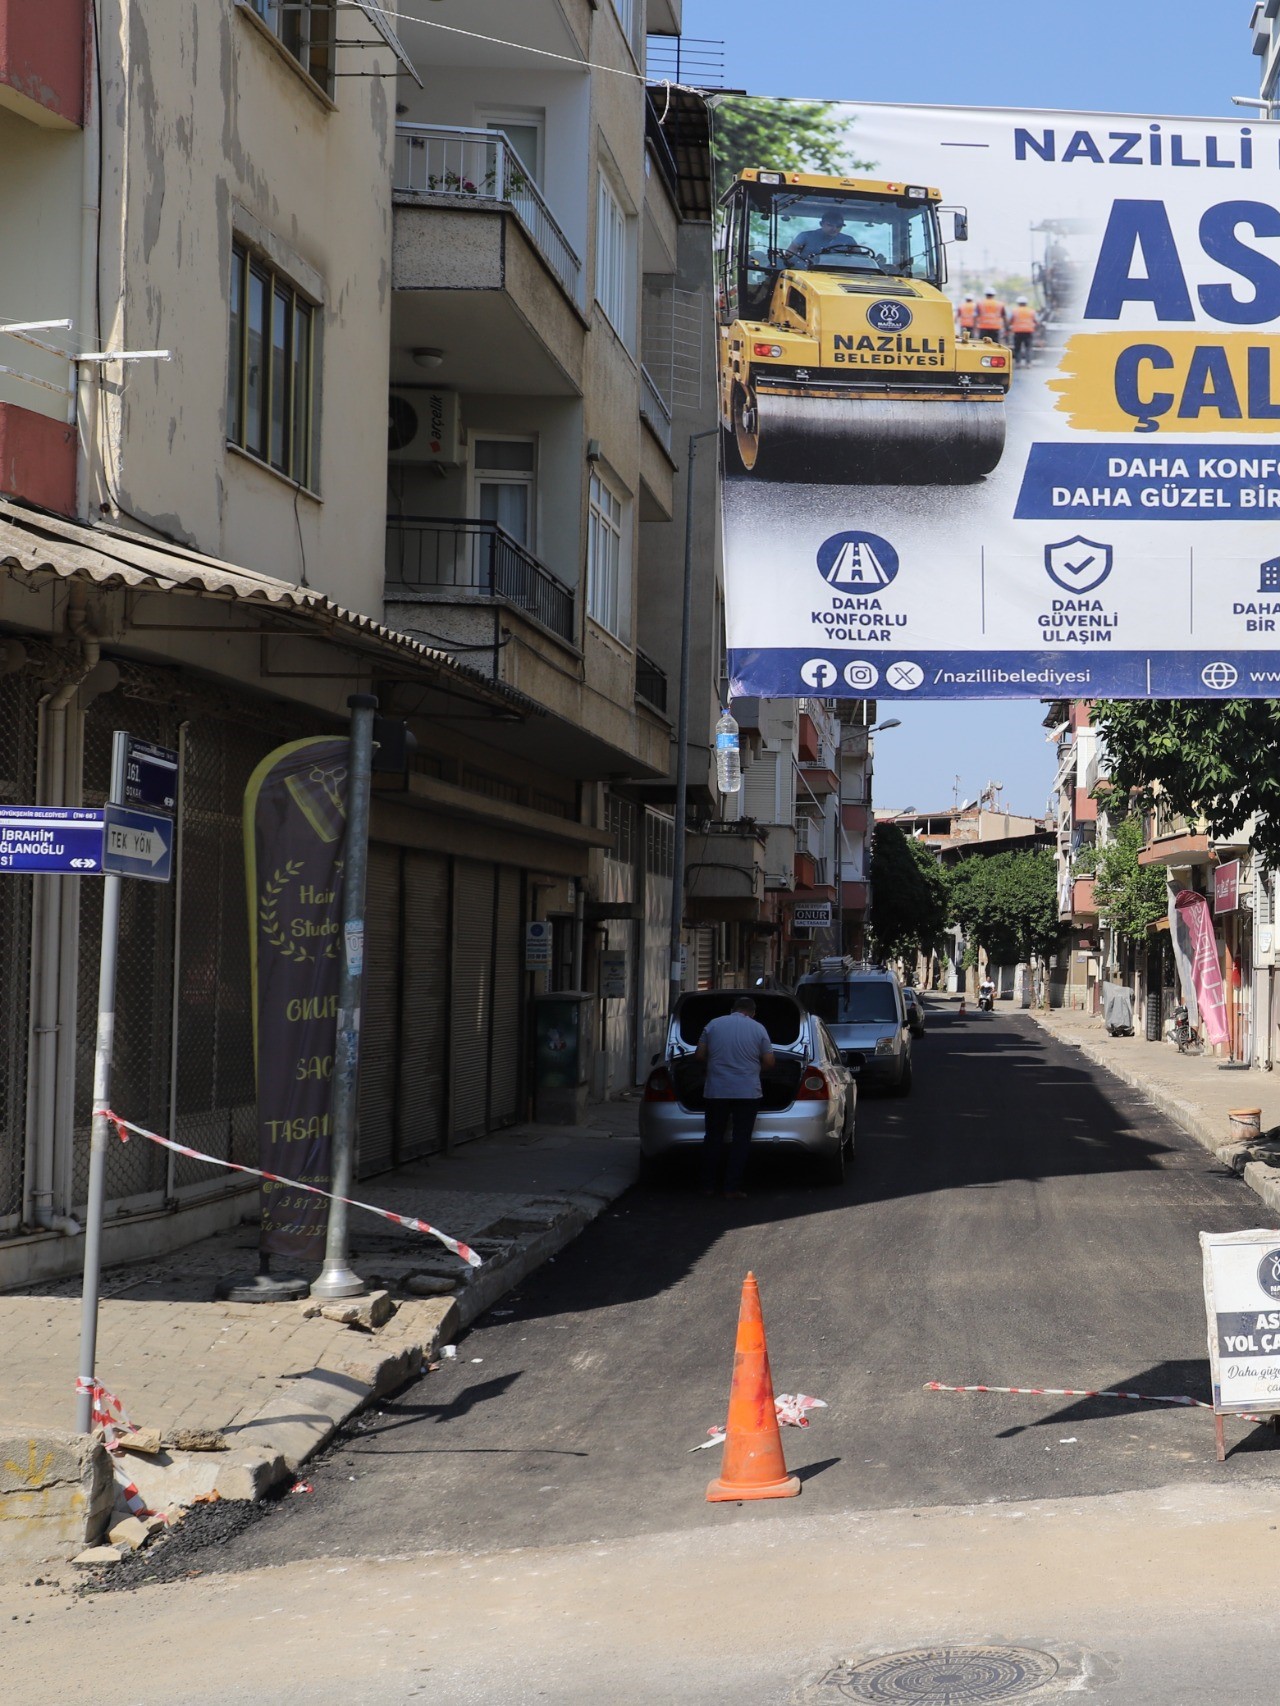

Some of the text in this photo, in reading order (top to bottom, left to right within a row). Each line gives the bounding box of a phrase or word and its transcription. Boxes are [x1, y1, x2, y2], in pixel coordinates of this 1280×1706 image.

[1014, 124, 1253, 169] NAZİLLİ
[834, 334, 945, 353] NAZİLLİ
[834, 353, 945, 366] BELEDİYESİ
[430, 394, 443, 440] arçelik
[1108, 458, 1189, 478] DAHA
[1052, 487, 1132, 507] DAHA
[1140, 484, 1231, 508] GÜZEL
[832, 597, 882, 611] DAHA
[1052, 599, 1104, 612] DAHA
[811, 611, 907, 627] KONFORLU
[1037, 612, 1118, 627] GÜVENLİ
[1246, 616, 1276, 632] BİR
[825, 627, 891, 642] YOLLAR
[1042, 629, 1112, 645] ULAŞIM
[933, 669, 1090, 686] /nazillibelediyesi
[2, 828, 54, 842] İBRAHİM
[111, 831, 152, 854] TEK YÖN
[300, 885, 336, 905] Hair
[797, 911, 827, 920] ONUR
[1224, 1335, 1258, 1352] YOL
[1227, 1364, 1258, 1379] Daha
